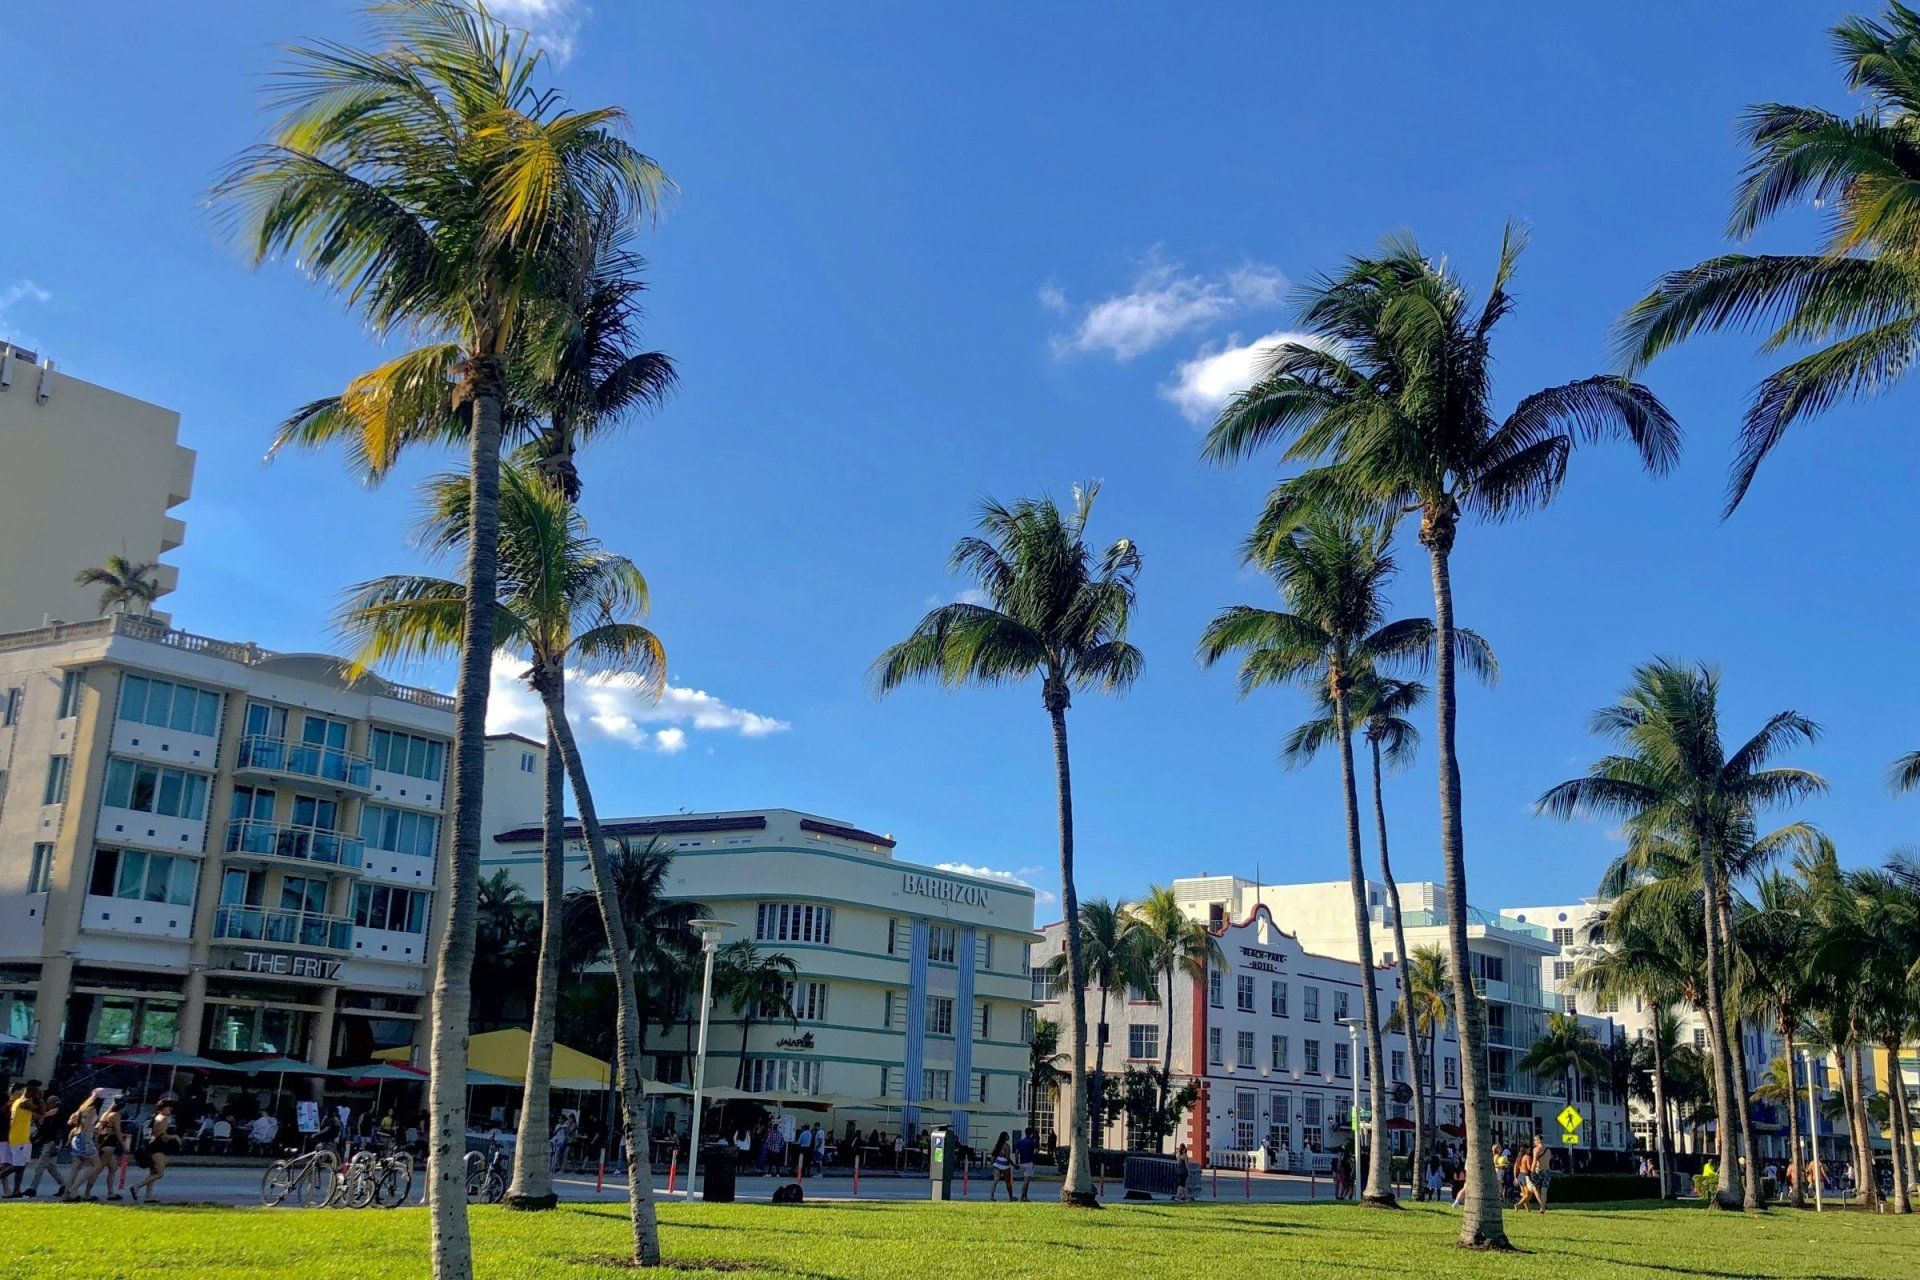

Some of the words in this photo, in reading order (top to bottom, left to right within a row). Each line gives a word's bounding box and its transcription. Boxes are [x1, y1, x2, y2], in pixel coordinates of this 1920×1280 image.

[903, 873, 991, 907] BARBIZON
[1242, 947, 1264, 959] BEACH
[1267, 951, 1284, 963] PARK
[1252, 960, 1275, 972] HOTEL
[243, 952, 288, 974] THE
[292, 956, 345, 981] FRITZ
